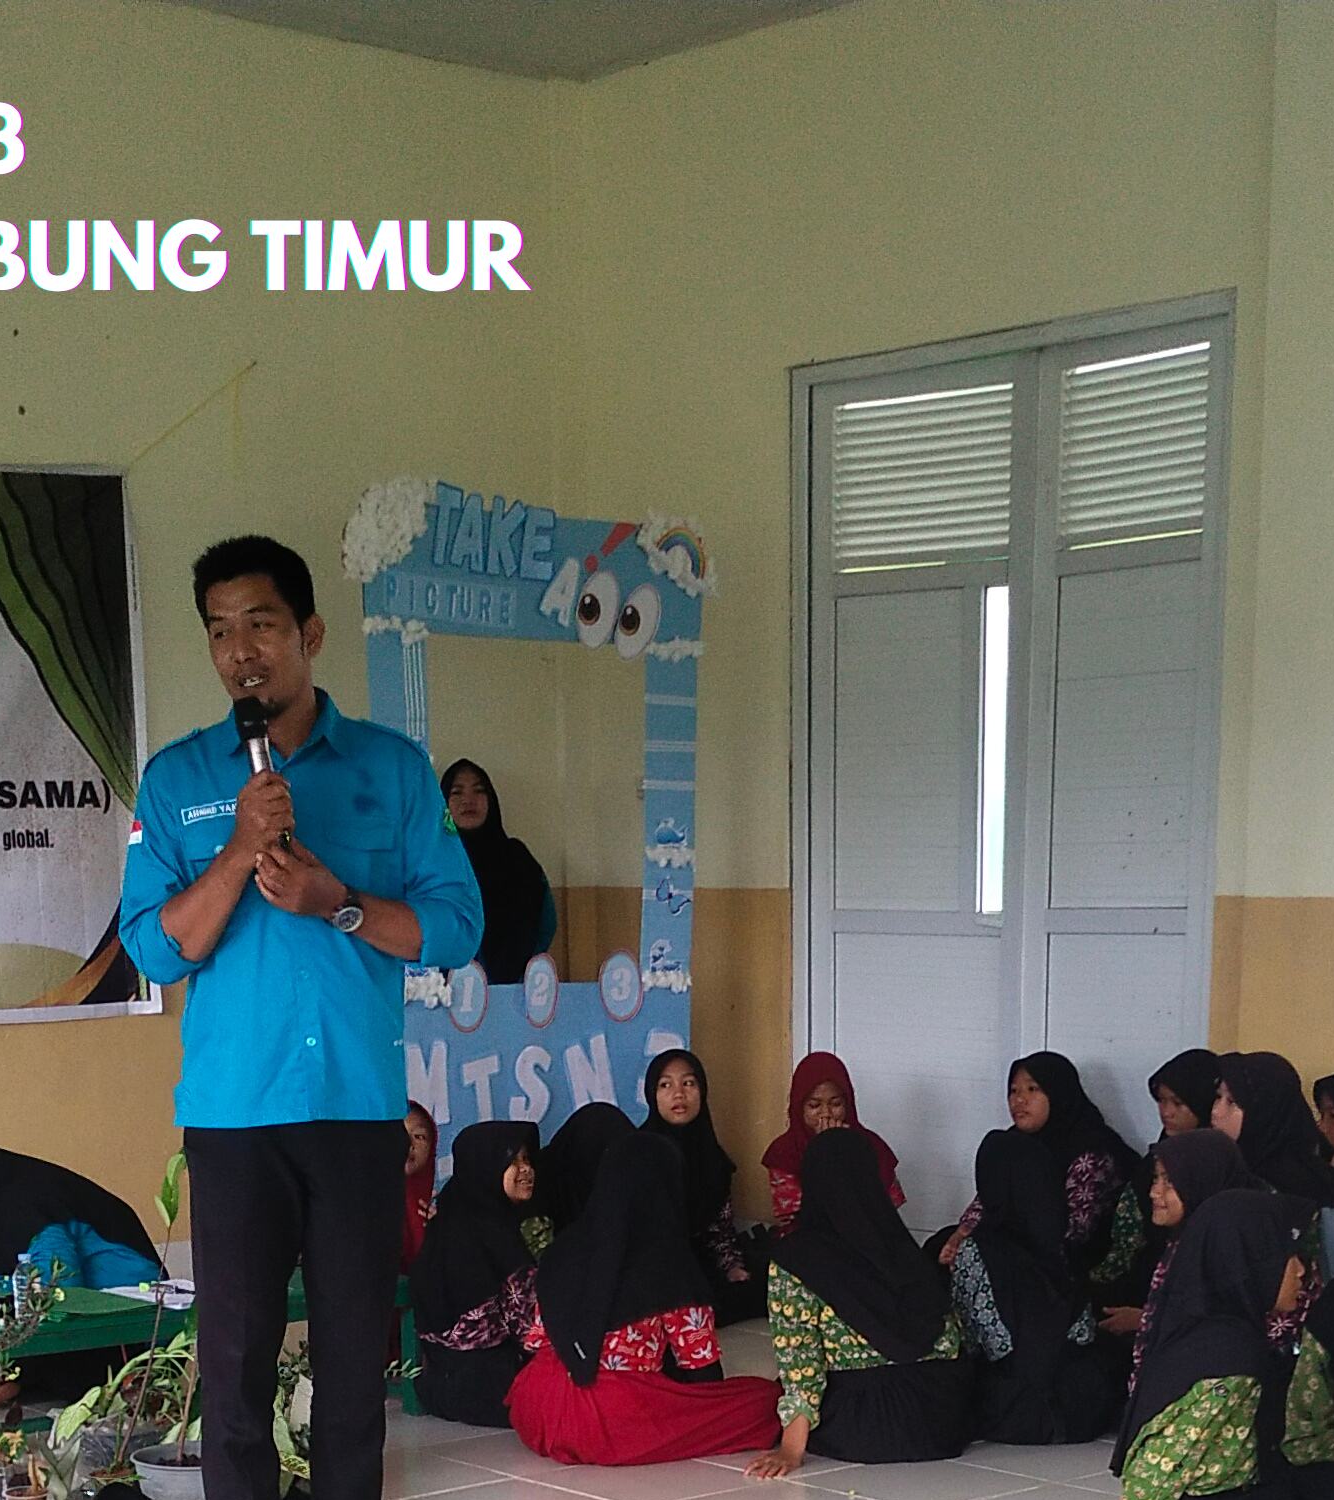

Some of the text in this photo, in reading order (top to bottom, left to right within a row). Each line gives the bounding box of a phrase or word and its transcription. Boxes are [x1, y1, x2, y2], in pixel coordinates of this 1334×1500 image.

[433, 481, 580, 627] TAKE A
[382, 573, 517, 627] PICTURE
[2, 826, 56, 853] global.
[459, 966, 633, 1014] 1 2 3
[405, 1033, 618, 1126] MTSN
